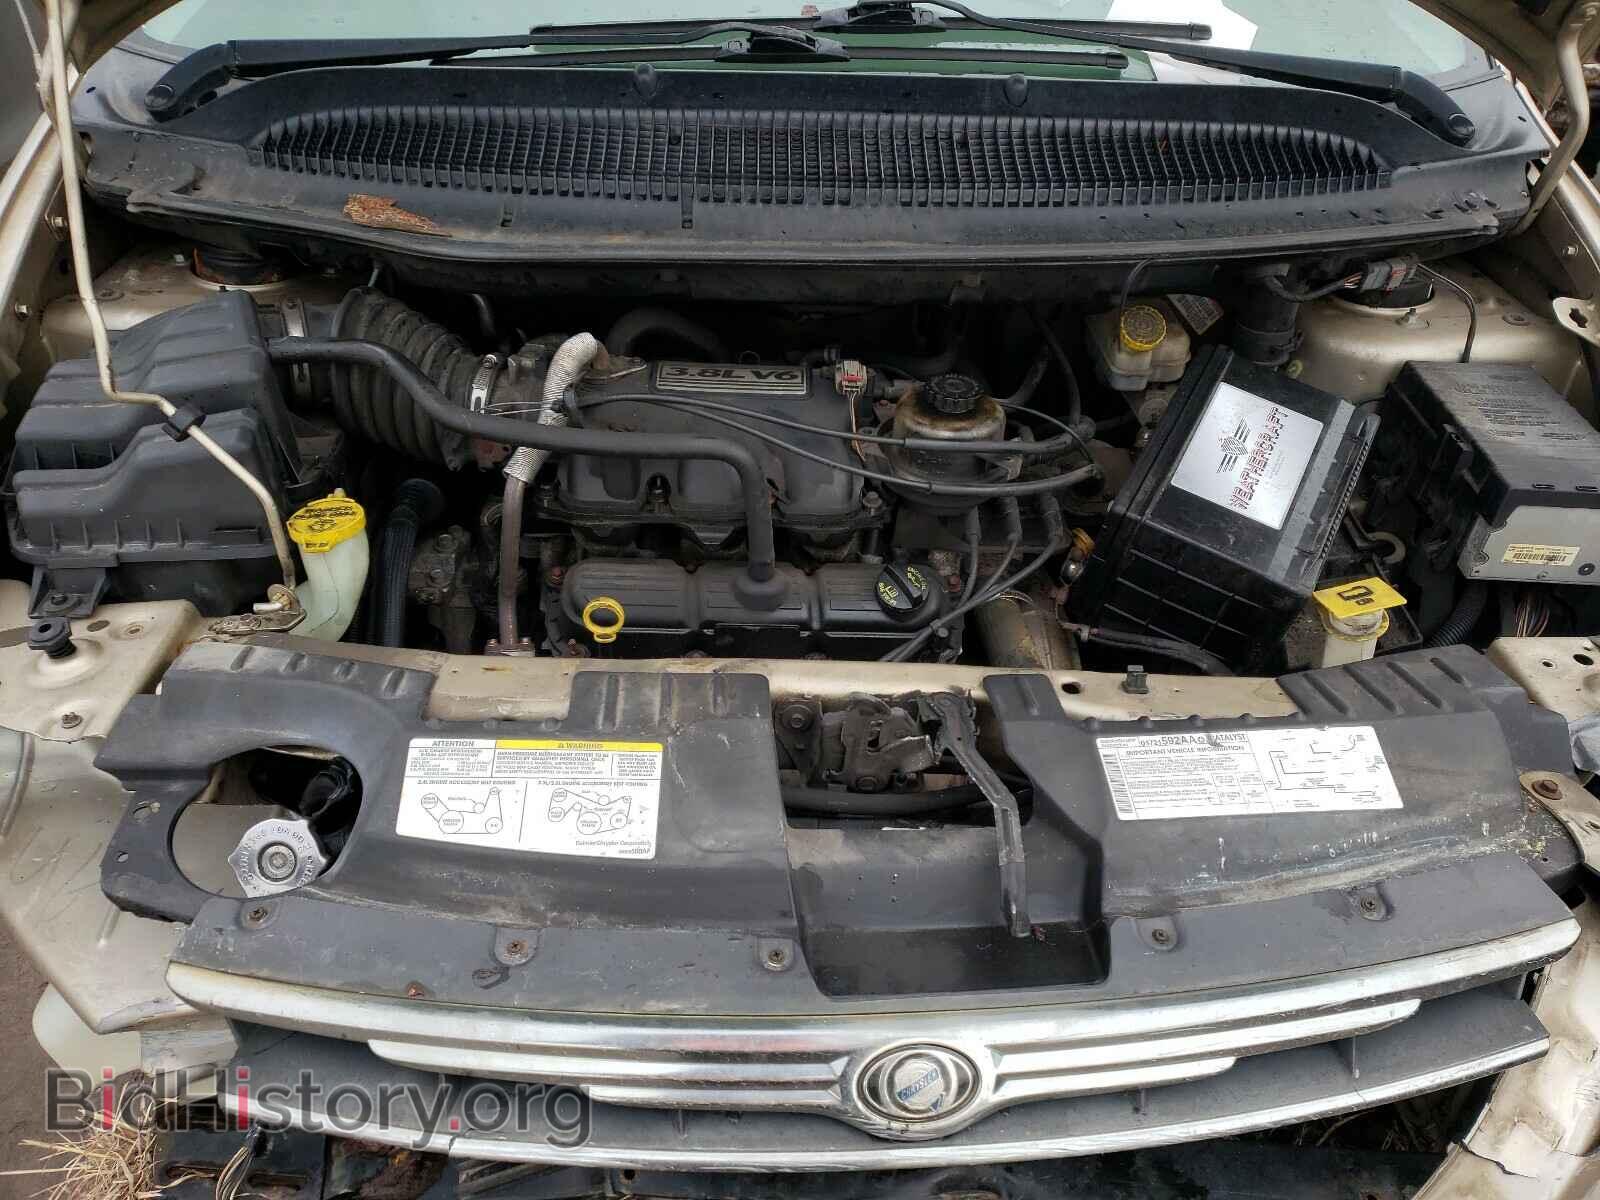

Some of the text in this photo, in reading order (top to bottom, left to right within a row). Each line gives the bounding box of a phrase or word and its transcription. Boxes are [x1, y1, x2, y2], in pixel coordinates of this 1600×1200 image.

[665, 367, 799, 381] 3.8L V6
[1230, 406, 1289, 510] WEATHERCRAFT
[566, 742, 604, 750] WARNING
